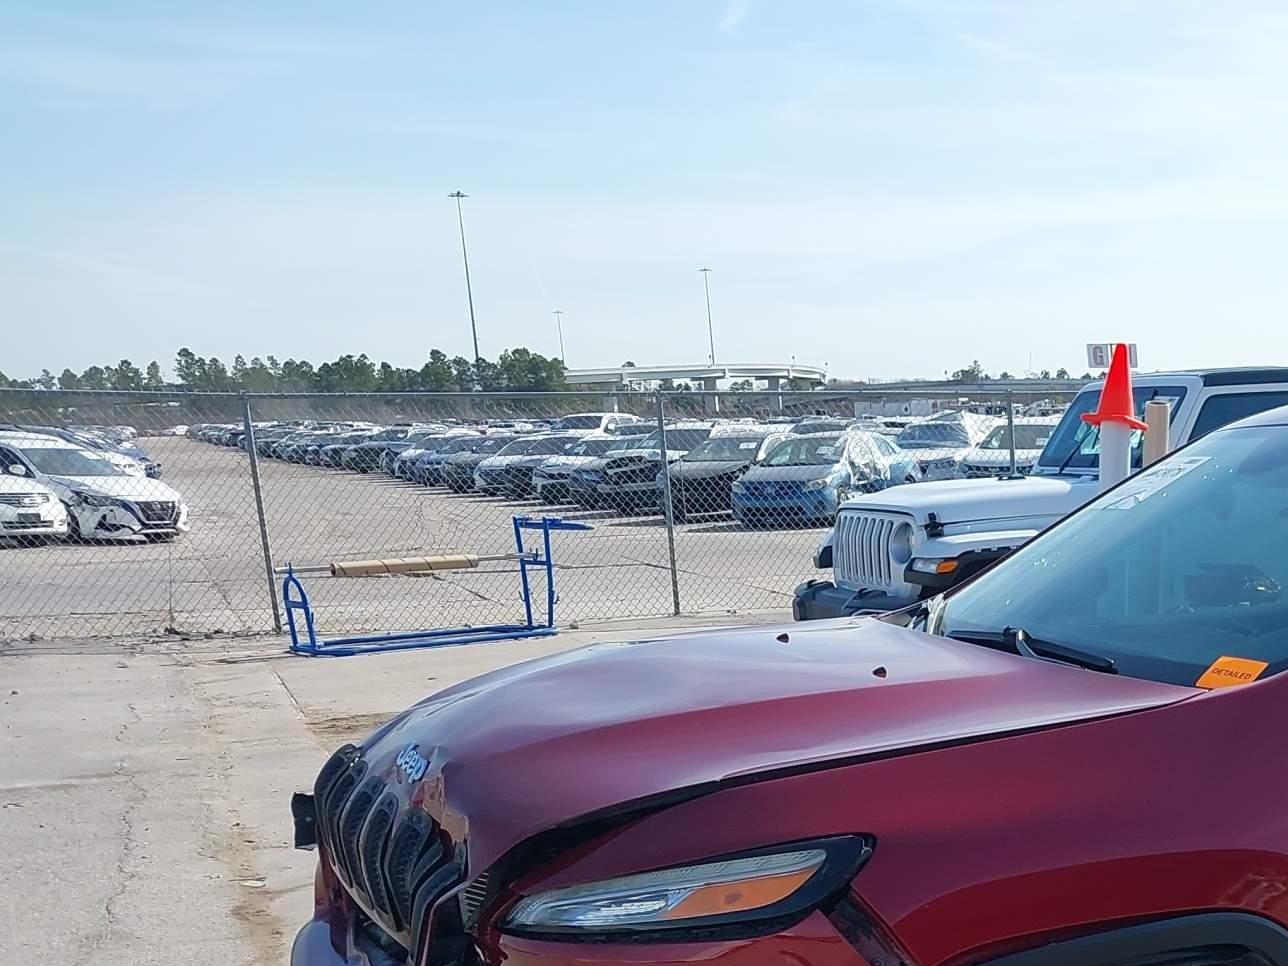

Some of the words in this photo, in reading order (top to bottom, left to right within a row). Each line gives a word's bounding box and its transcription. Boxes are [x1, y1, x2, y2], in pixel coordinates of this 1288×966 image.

[1093, 345, 1105, 366] G
[1211, 667, 1253, 681] DETAILED
[396, 742, 428, 785] Jeep
